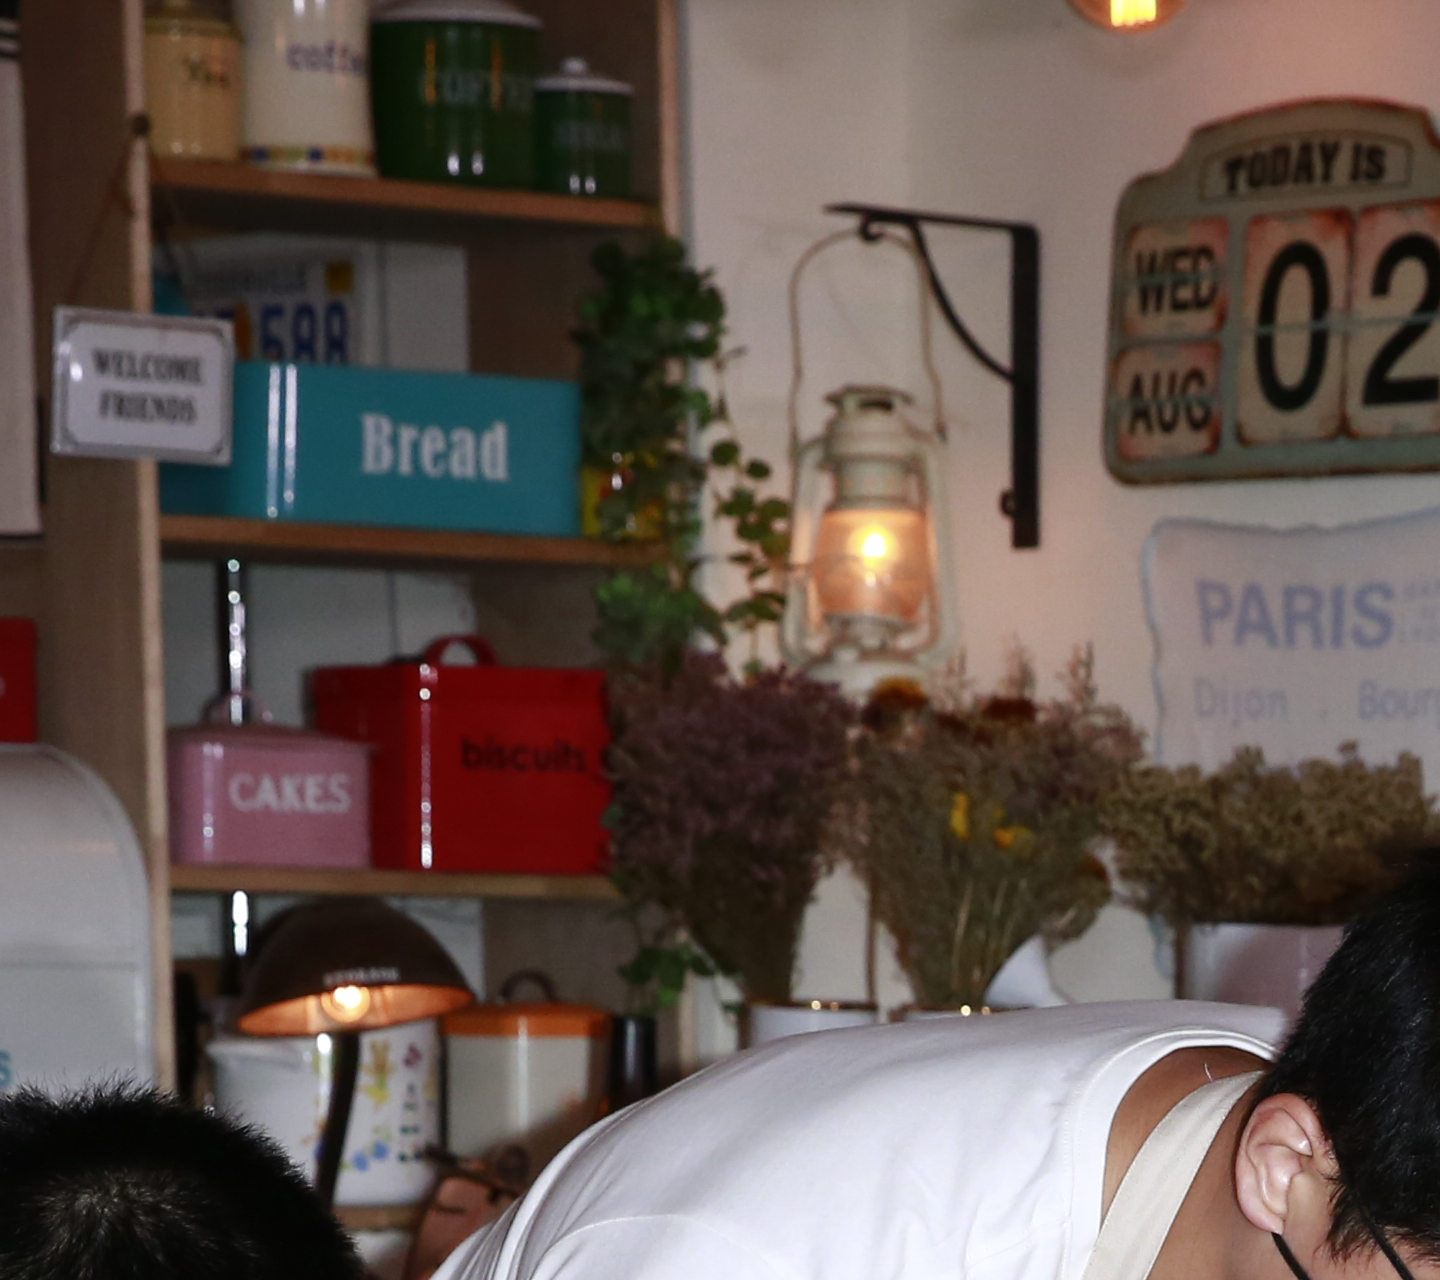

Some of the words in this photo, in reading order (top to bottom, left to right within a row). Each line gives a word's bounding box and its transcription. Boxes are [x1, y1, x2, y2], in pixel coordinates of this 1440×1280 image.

[1222, 139, 1340, 192] TODAY
[1347, 141, 1387, 183] IS
[1134, 245, 1219, 318] WED
[92, 348, 203, 386] WELCOME
[98, 390, 198, 426] FRIENDS
[1126, 366, 1211, 437] AUG
[359, 411, 510, 482] Bread
[1194, 577, 1398, 652] PARIS
[1193, 676, 1288, 732] Dijon
[462, 736, 588, 774] biscuits
[227, 770, 353, 815] CAKES
